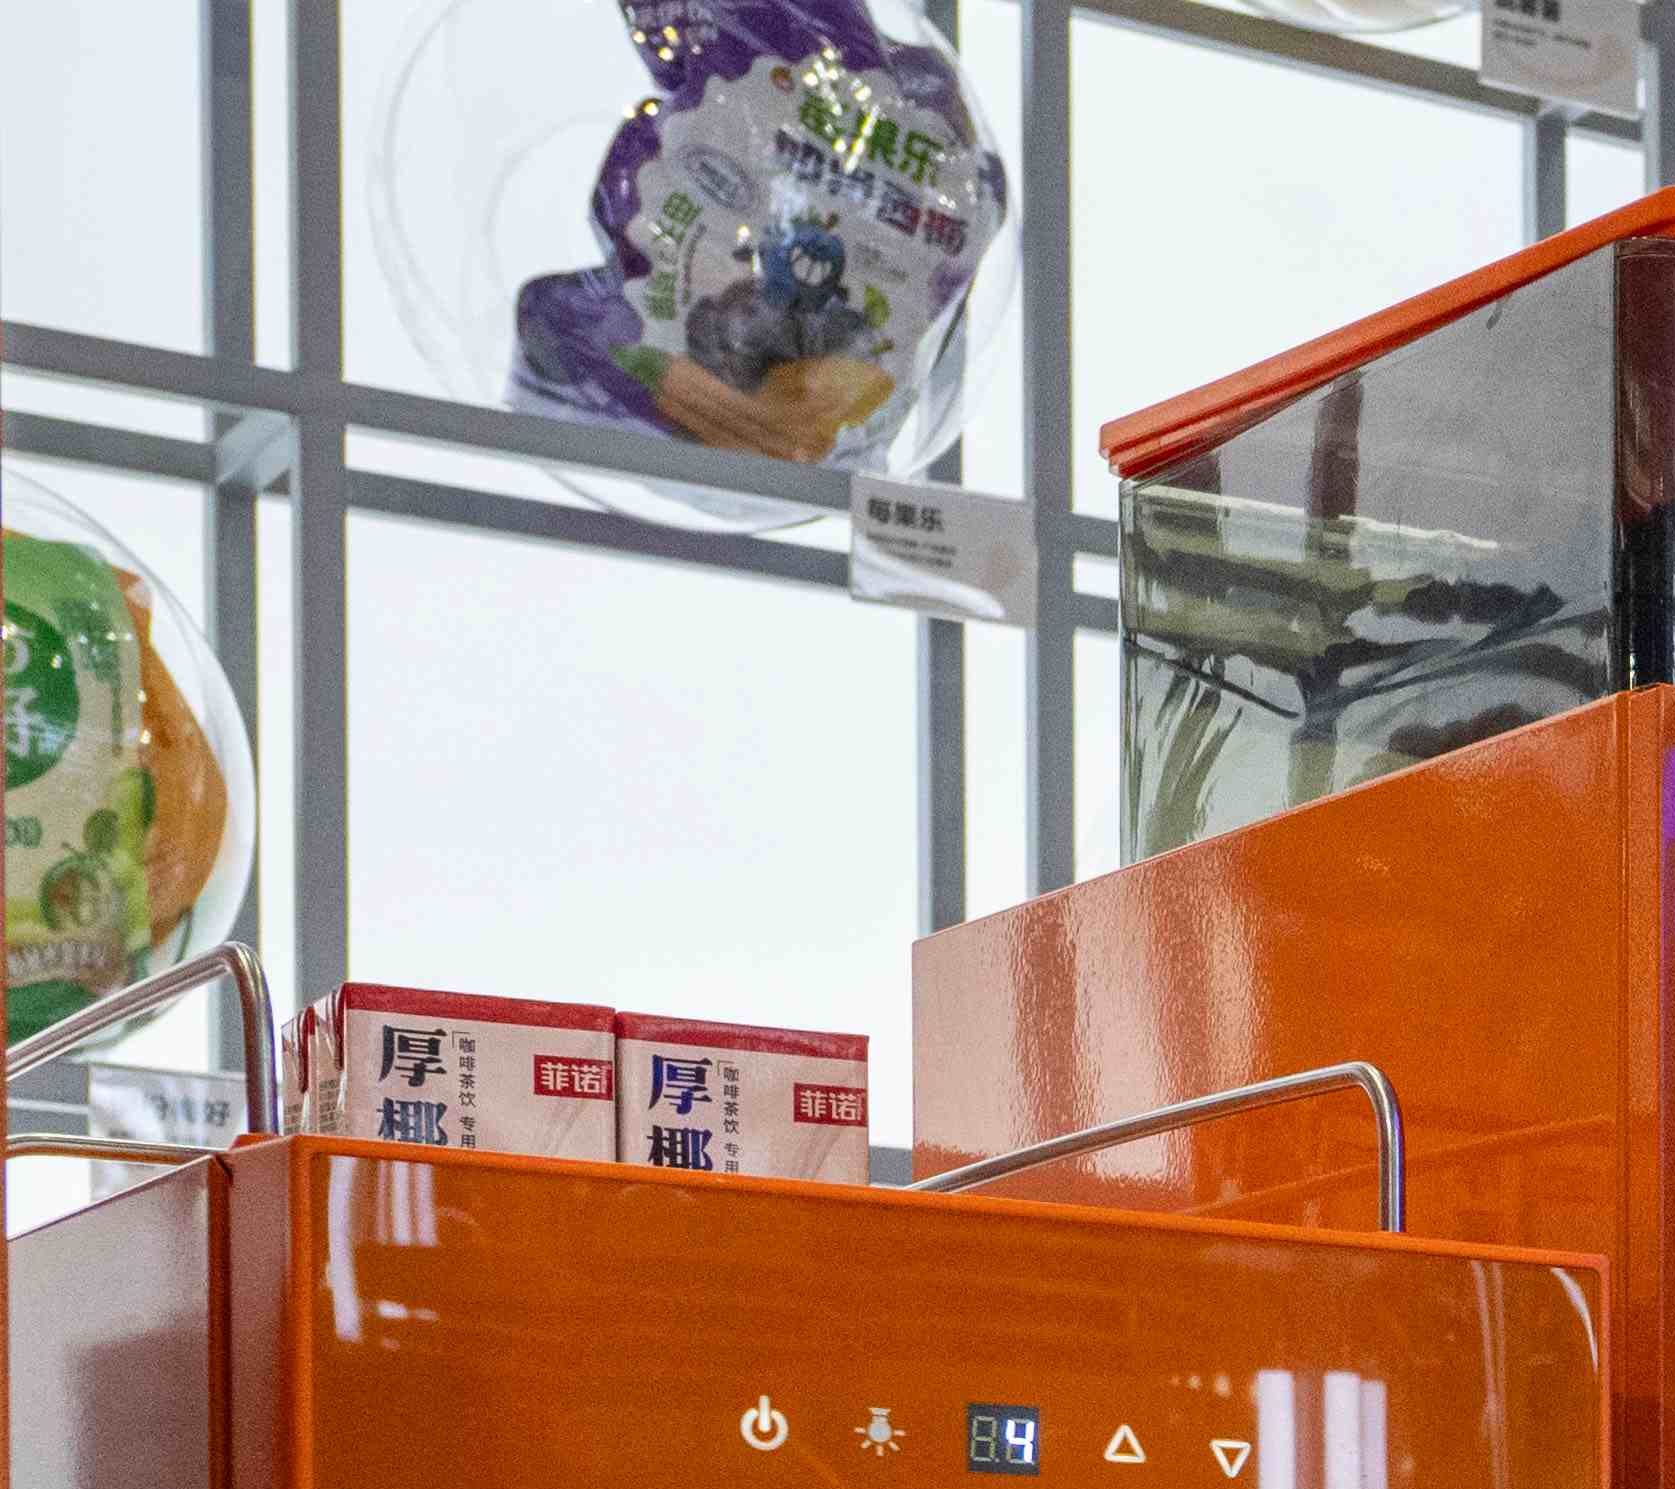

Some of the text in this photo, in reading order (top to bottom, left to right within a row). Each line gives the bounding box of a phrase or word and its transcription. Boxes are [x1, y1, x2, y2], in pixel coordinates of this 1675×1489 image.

[376, 1024, 449, 1146] 厚椰
[458, 1036, 477, 1108] 咖啡茶饮
[541, 1061, 603, 1094] 菲诺
[722, 1066, 740, 1136] 咖啡茶饮
[799, 1089, 858, 1121] 菲诺
[647, 1054, 714, 1172] 厚椰
